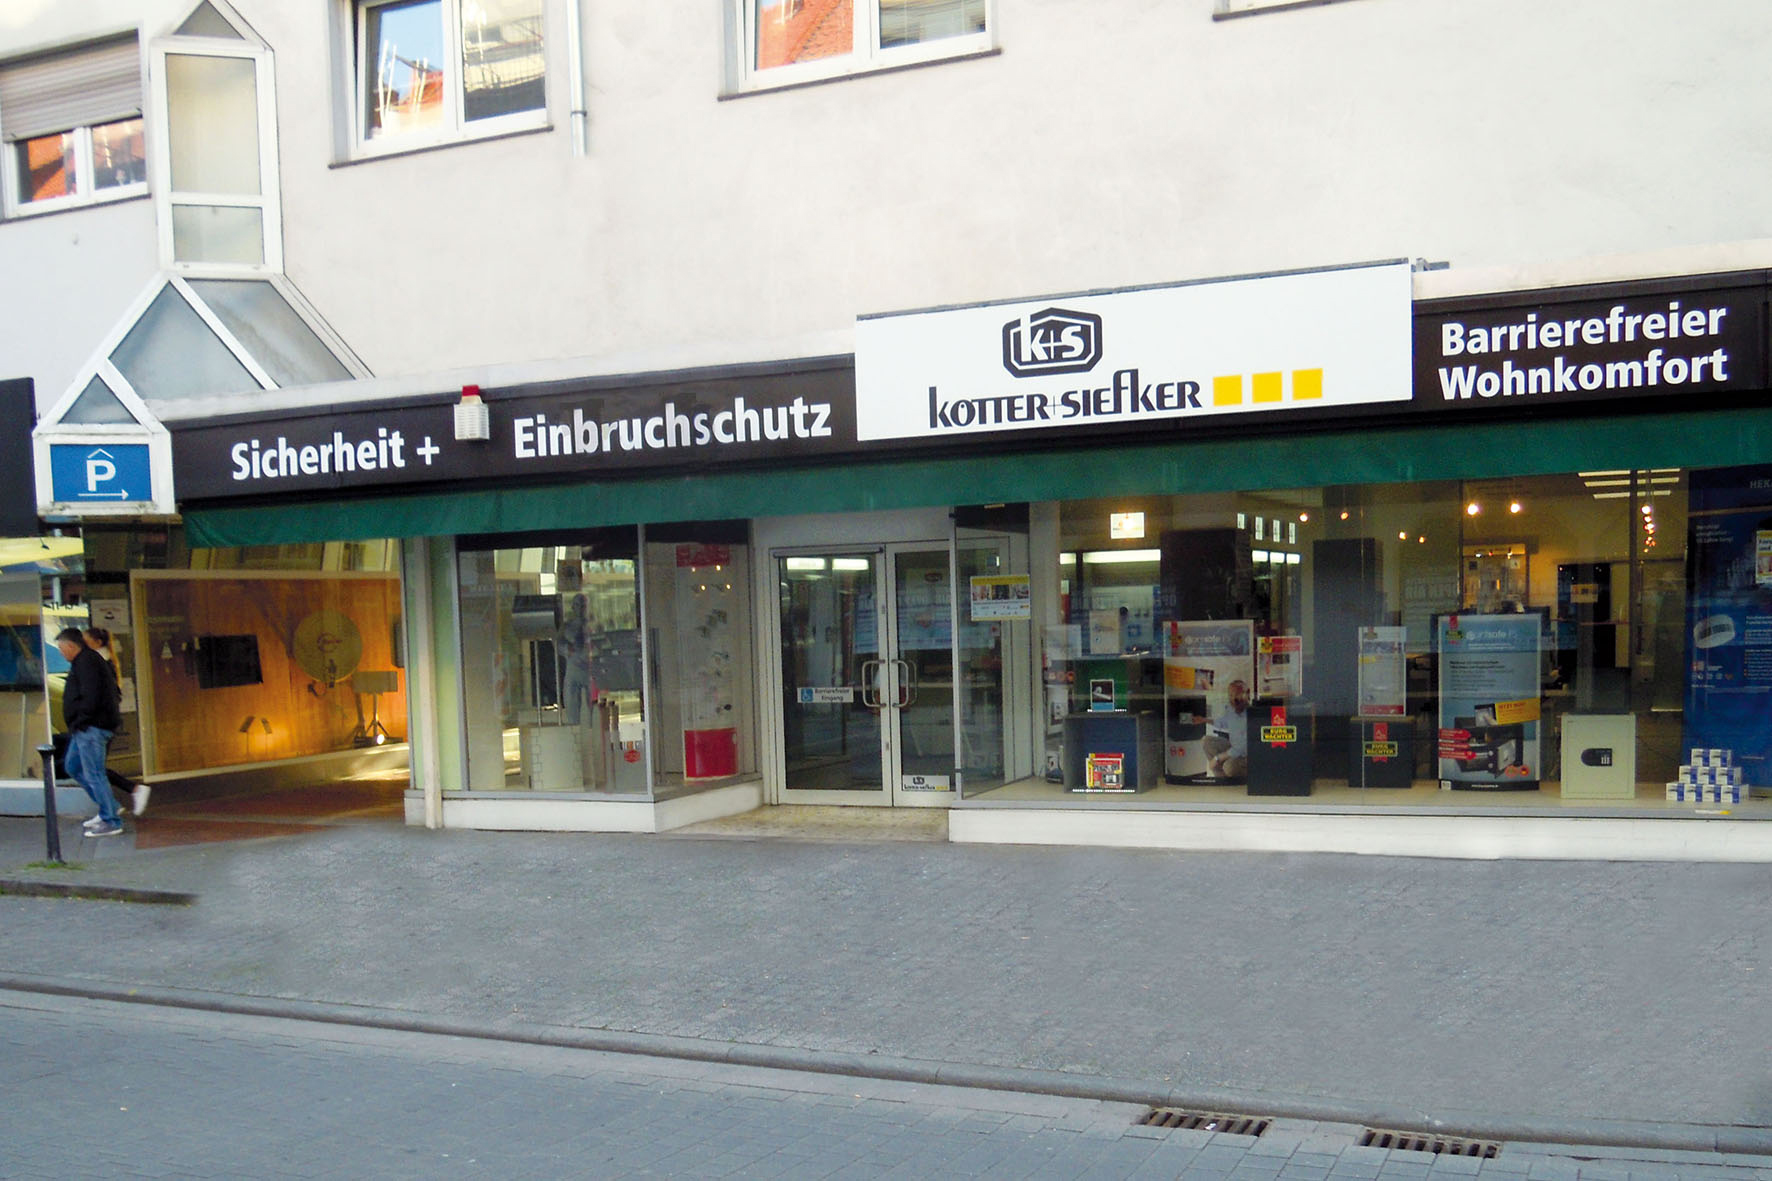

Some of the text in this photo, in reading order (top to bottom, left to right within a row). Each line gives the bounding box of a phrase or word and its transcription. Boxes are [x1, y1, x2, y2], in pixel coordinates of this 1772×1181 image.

[1441, 301, 1727, 357] Barrierefreier
[1438, 348, 1729, 401] Wohnkomfort
[231, 396, 832, 480] Sicherheit + Einbruchschutz
[86, 459, 116, 492] P
